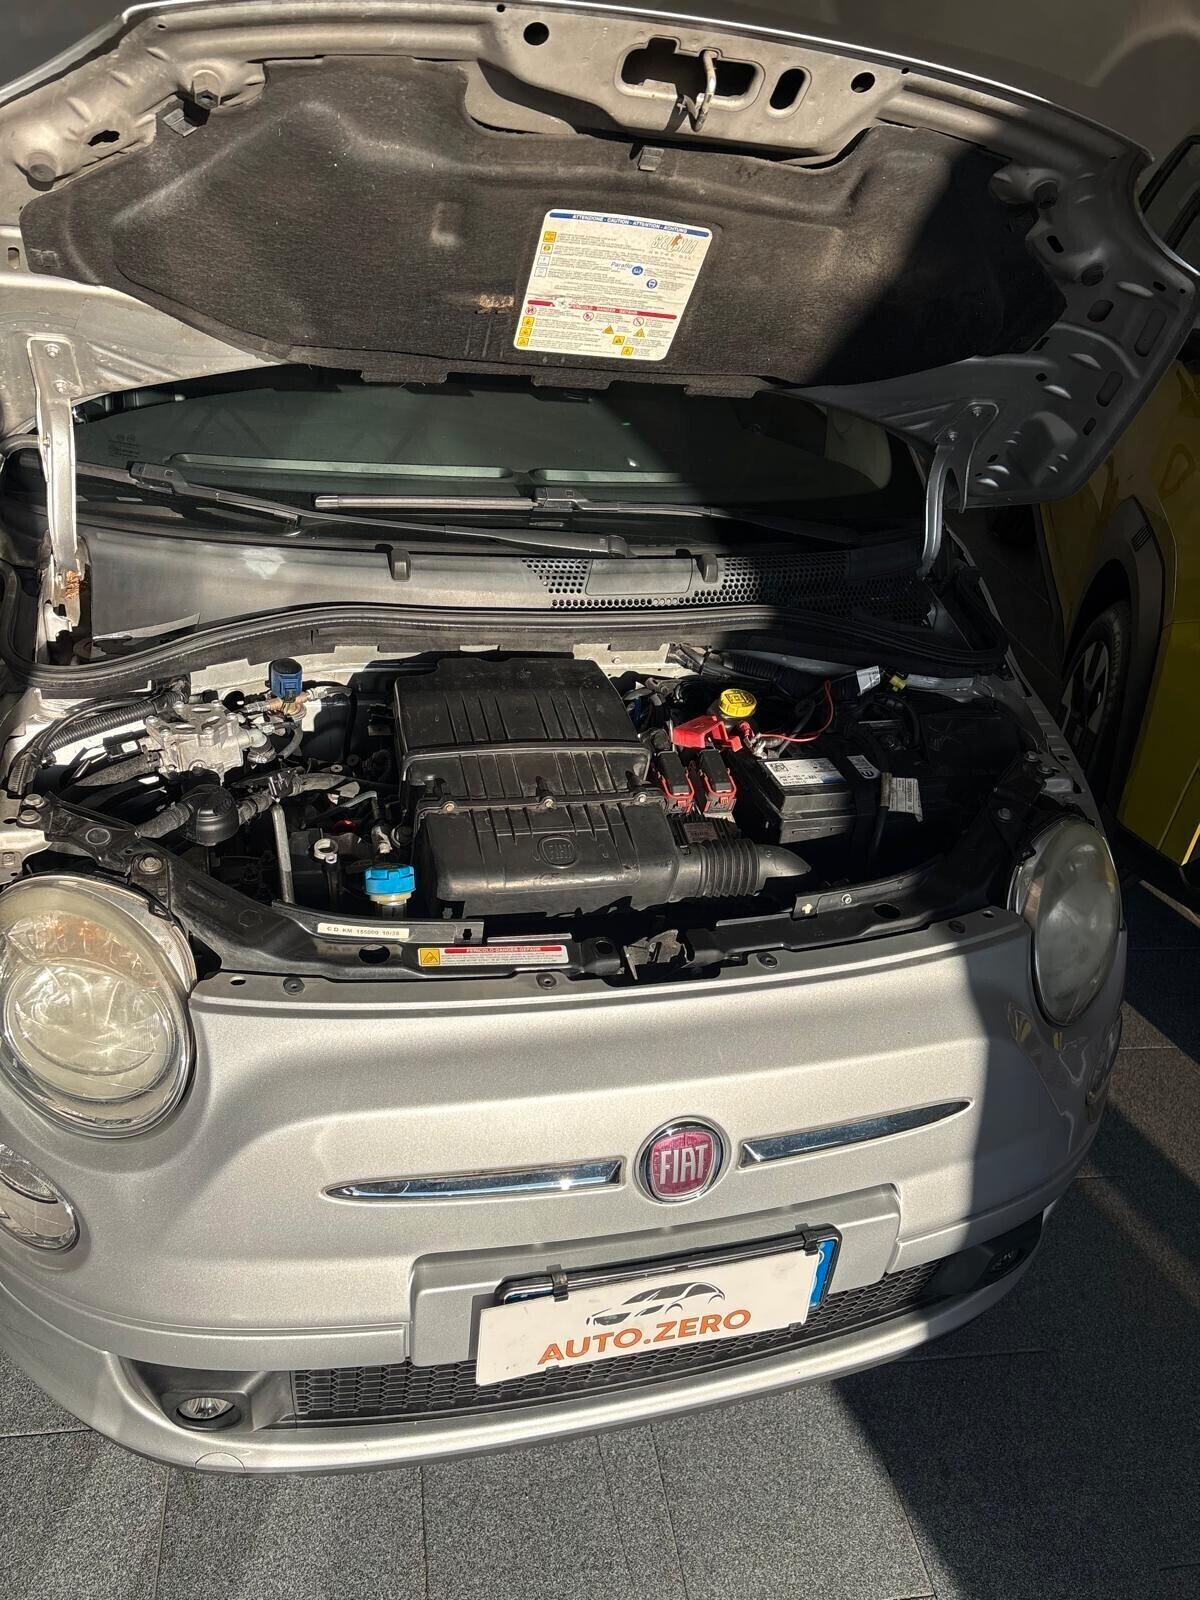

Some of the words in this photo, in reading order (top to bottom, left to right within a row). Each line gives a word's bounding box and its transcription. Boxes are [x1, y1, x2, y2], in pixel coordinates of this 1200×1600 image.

[607, 217, 629, 226] CAUTION
[633, 220, 660, 230] ATTENTION
[660, 1144, 708, 1184] FIAT
[537, 1309, 751, 1365] AUTO.ZERO
